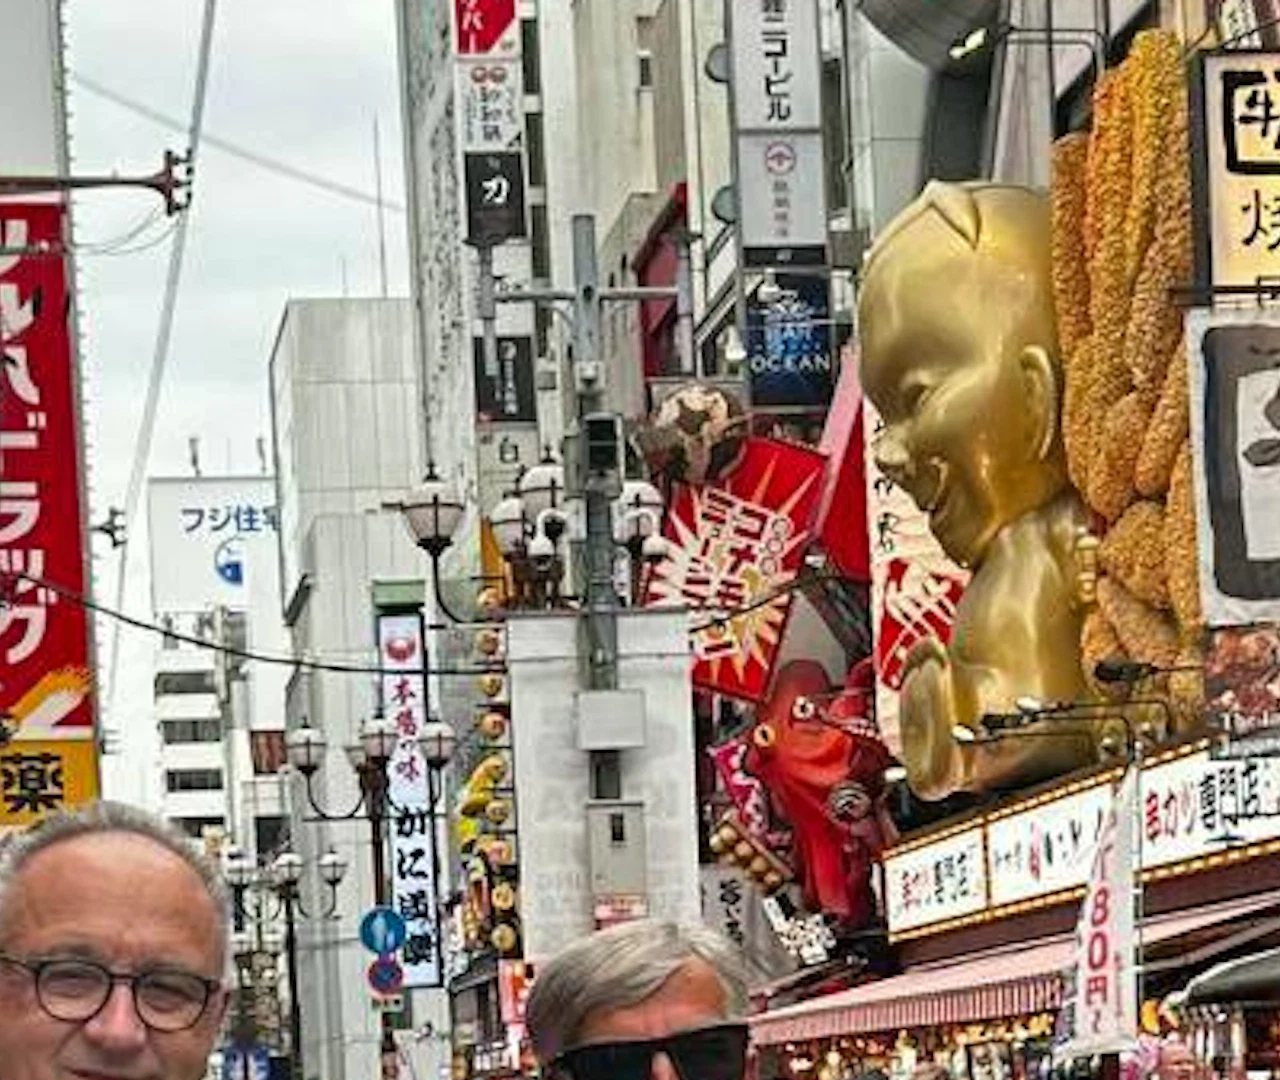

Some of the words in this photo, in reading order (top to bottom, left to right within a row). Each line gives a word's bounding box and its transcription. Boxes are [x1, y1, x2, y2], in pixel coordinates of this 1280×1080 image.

[750, 353, 831, 374] OCEAN
[181, 504, 281, 534] フジ住宅
[395, 678, 421, 783] 本場の味
[0, 752, 64, 814] 薬
[1144, 762, 1260, 844] 串カツ専門店
[395, 806, 433, 966] かに道楽
